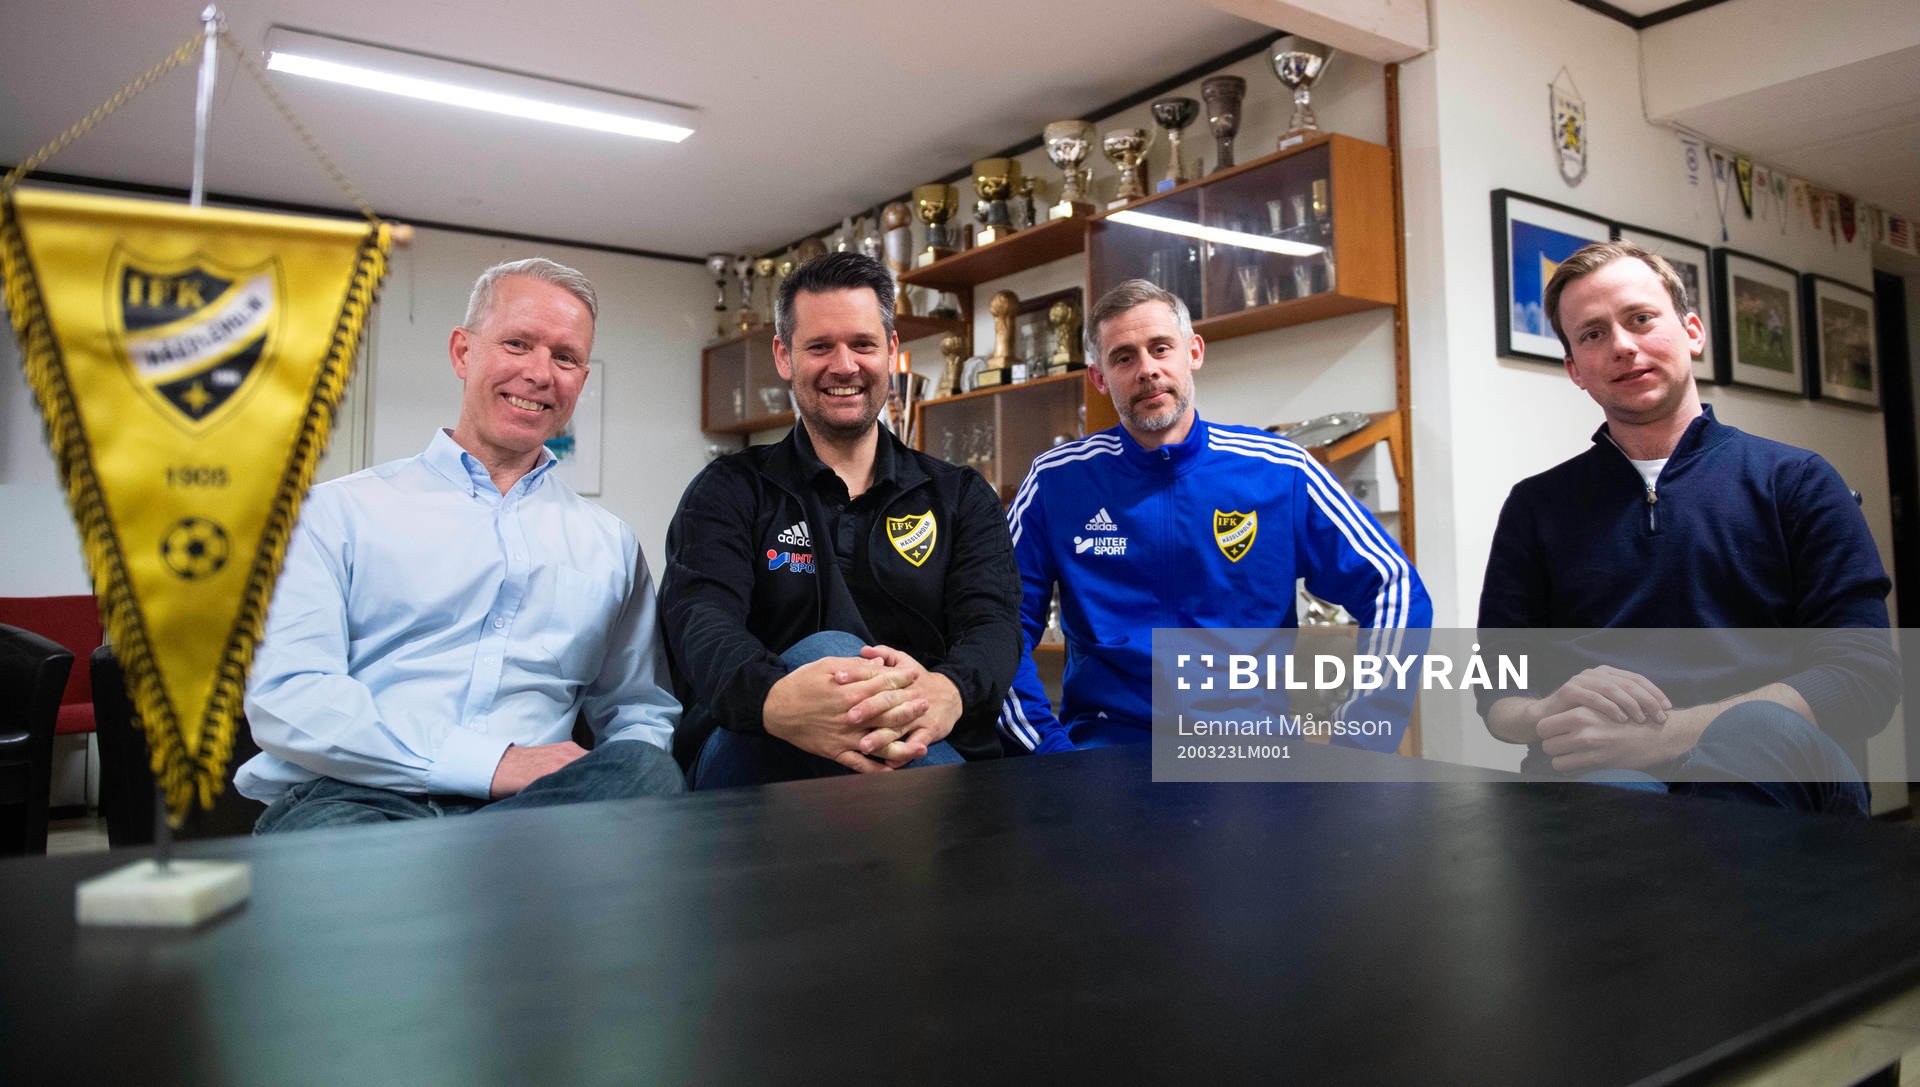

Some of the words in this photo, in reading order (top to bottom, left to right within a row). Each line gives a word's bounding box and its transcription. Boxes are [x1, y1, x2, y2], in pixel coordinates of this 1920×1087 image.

[127, 274, 206, 309] IFK
[891, 521, 913, 531] IFK
[1218, 517, 1237, 526] IFK
[1085, 522, 1118, 531] adidas
[1095, 536, 1127, 546] INTER
[1094, 546, 1126, 555] SPORT
